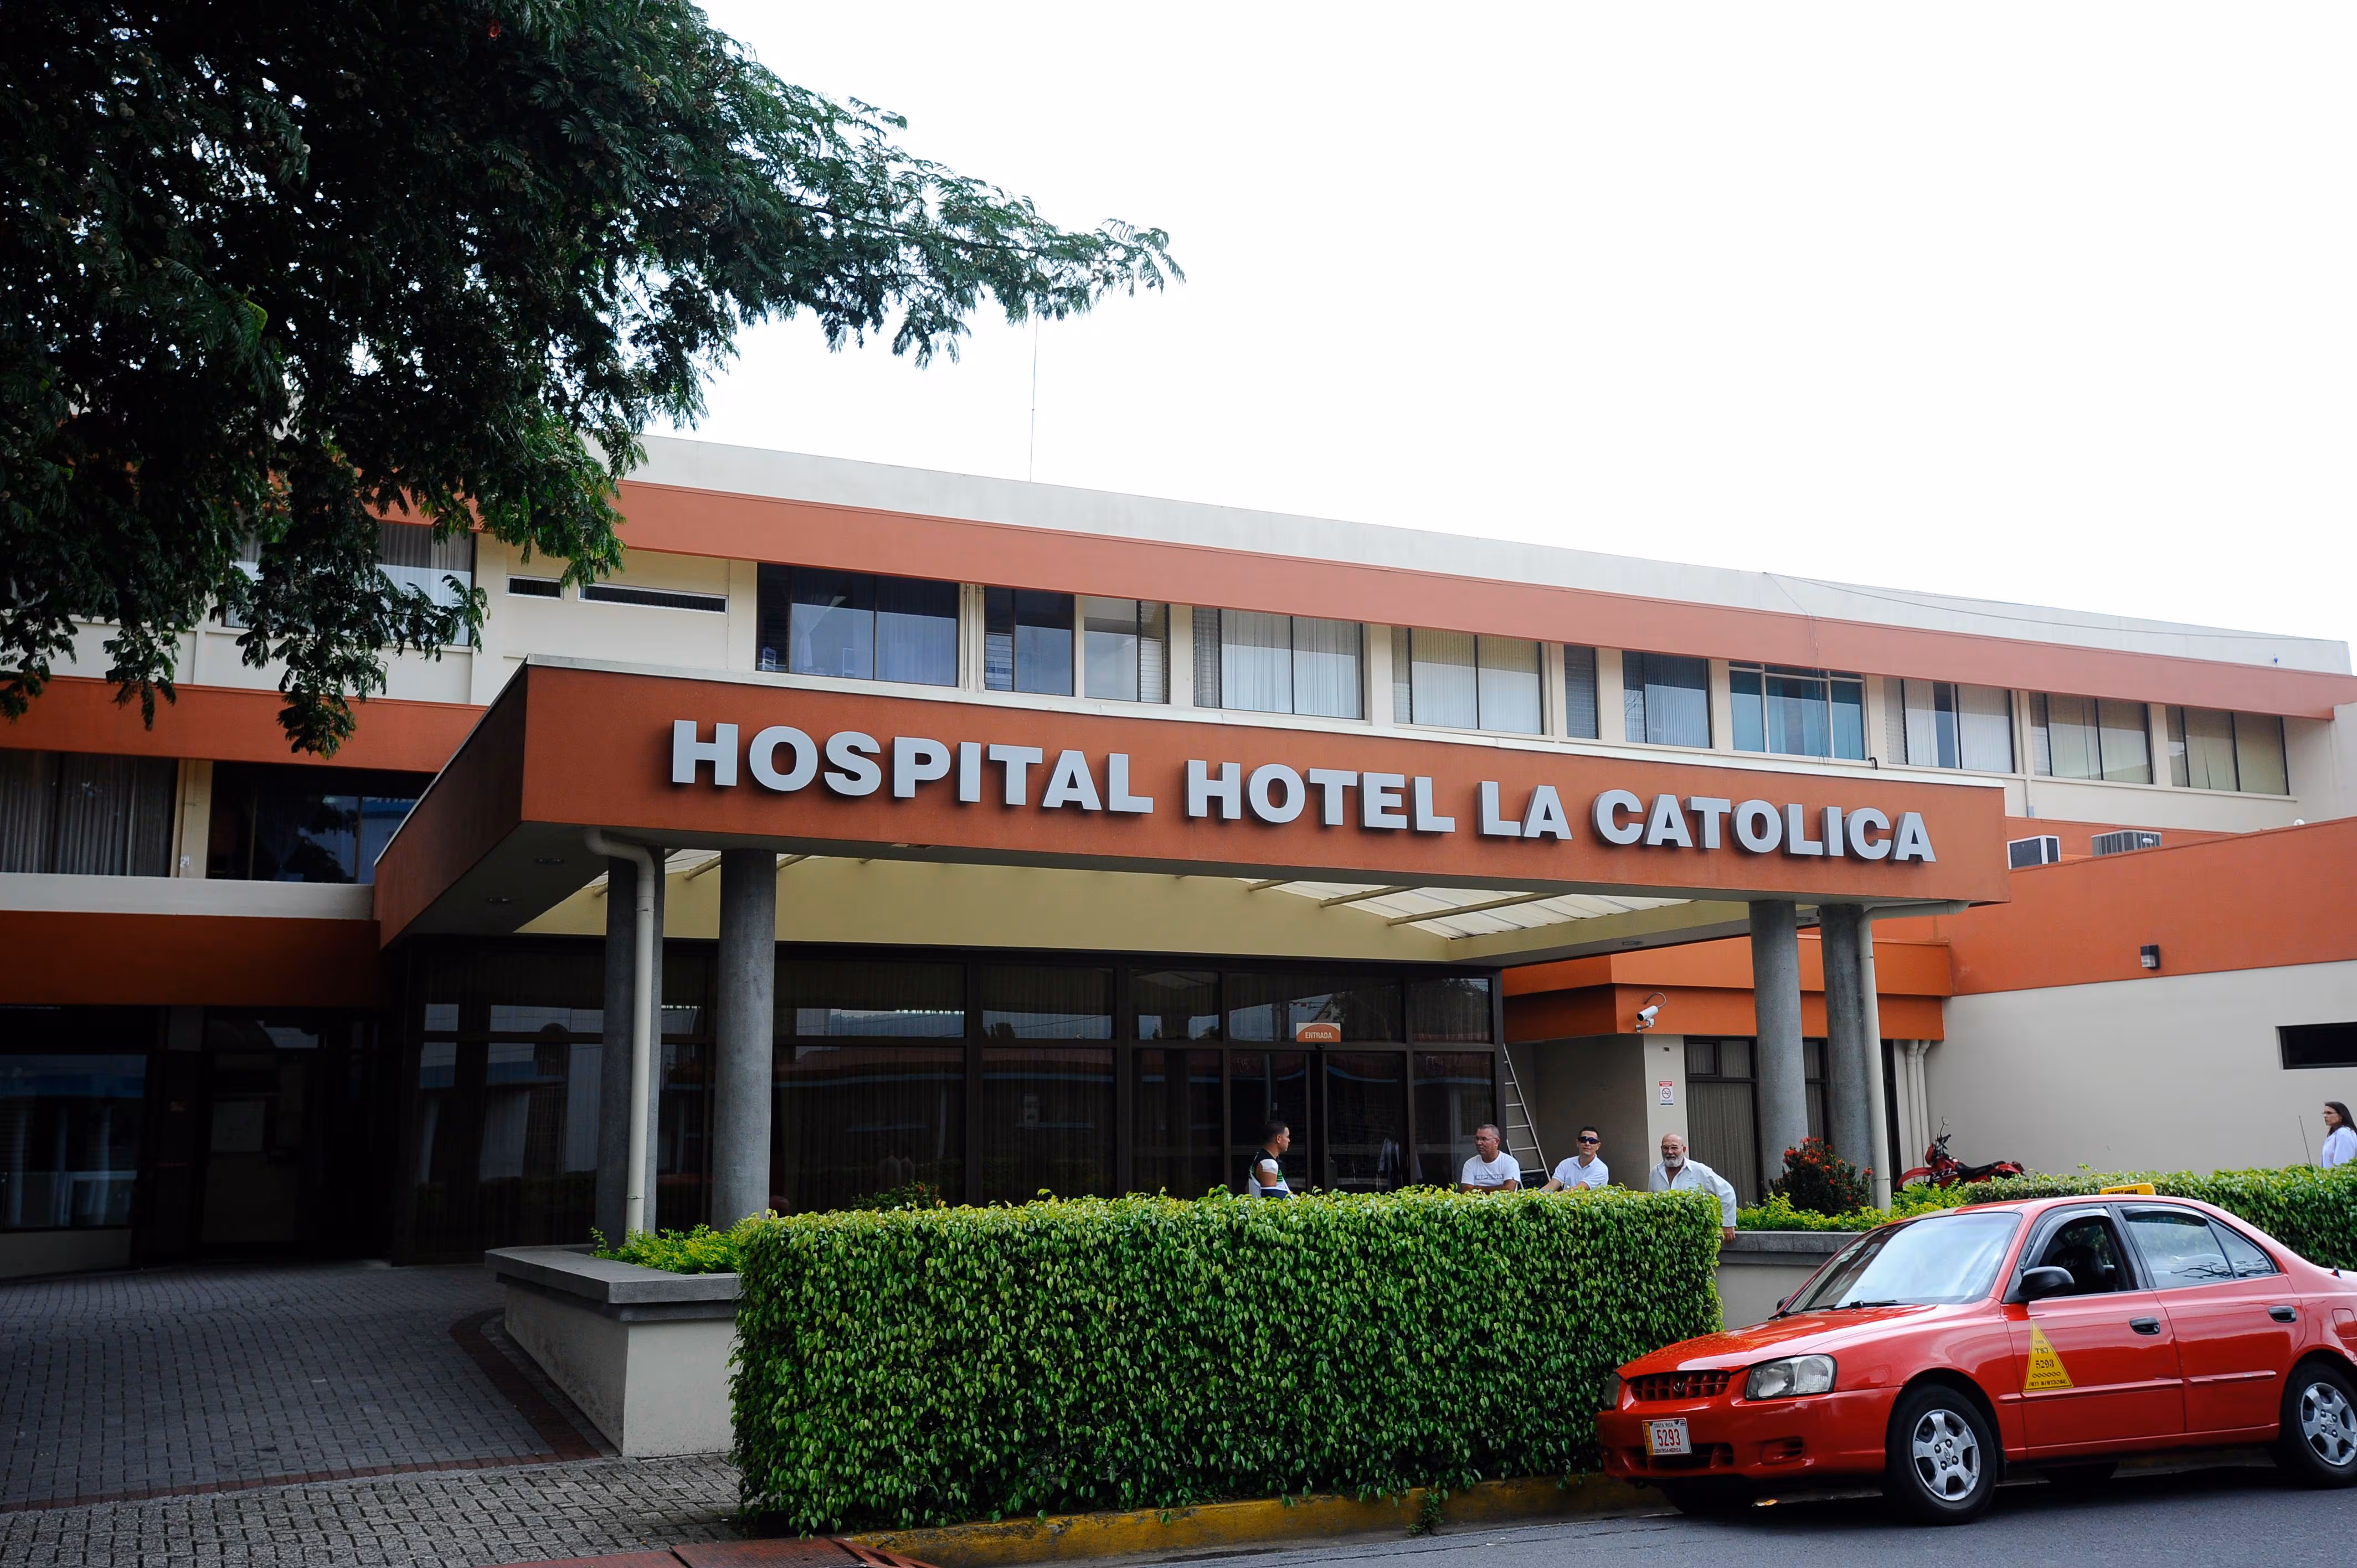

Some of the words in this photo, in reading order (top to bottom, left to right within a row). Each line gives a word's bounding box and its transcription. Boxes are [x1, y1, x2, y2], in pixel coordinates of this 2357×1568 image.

[672, 719, 1154, 813] HOSPITAL
[1185, 759, 1455, 833] HOTEL
[1477, 780, 1572, 840] LA
[1592, 788, 1937, 863] CATOLICA
[2035, 1359, 2055, 1369] 5293
[1656, 1428, 1681, 1447] 5293
